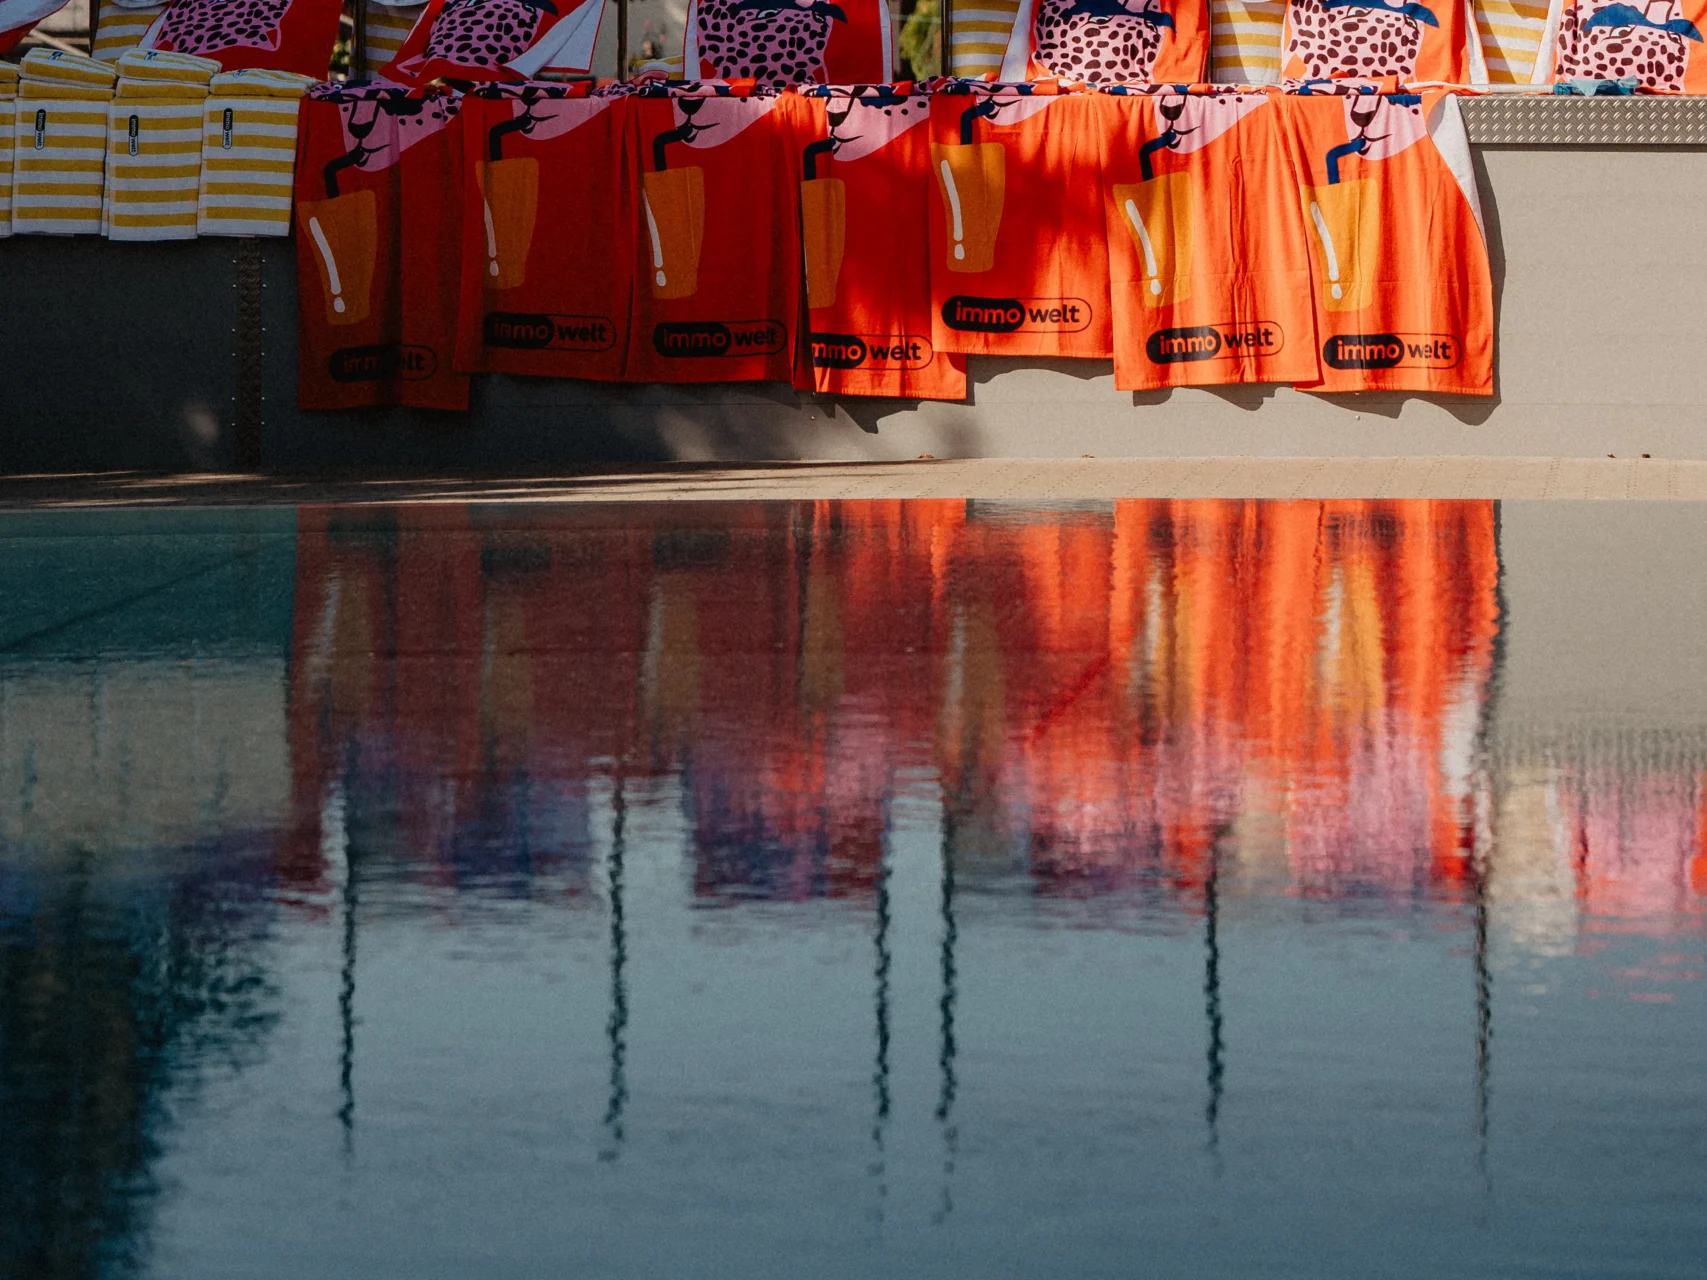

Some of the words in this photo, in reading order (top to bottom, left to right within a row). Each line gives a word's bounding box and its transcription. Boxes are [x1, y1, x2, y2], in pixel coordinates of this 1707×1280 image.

[955, 300, 1021, 325] immo
[1027, 303, 1080, 324] welt
[492, 318, 549, 340] immo
[556, 322, 606, 342] welt
[663, 327, 727, 348] immo
[734, 326, 776, 347] welt
[1159, 334, 1217, 355] immo
[1223, 327, 1274, 353] welt
[811, 341, 862, 361] mmo
[869, 341, 921, 361] welt
[1336, 339, 1401, 361] immo
[1407, 339, 1451, 360] welt
[343, 353, 380, 373] imm
